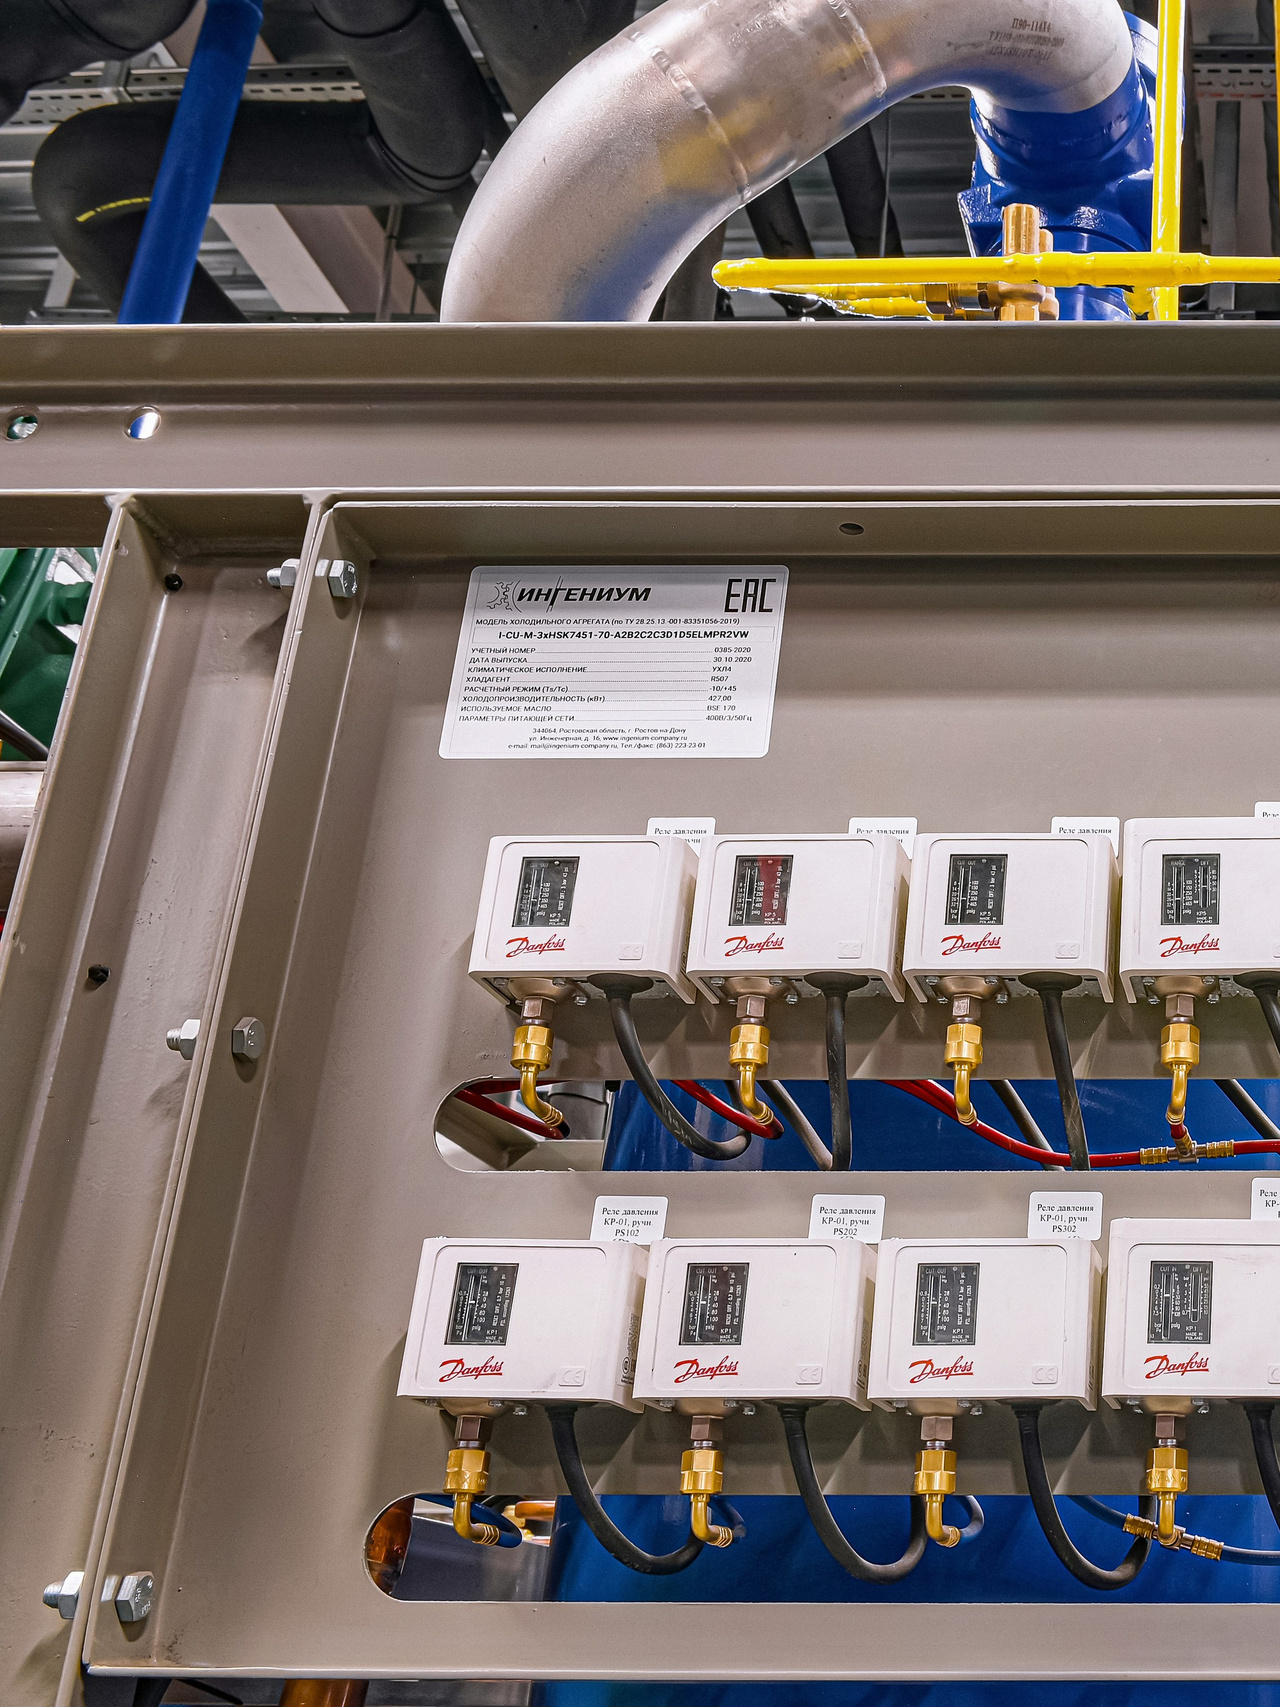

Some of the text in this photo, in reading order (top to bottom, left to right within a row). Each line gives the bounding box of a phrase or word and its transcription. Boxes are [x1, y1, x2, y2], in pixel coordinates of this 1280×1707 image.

[516, 583, 652, 607] ИНГЕНИУМ
[724, 578, 777, 613] EAC
[475, 618, 509, 626] МОДЕЛЬ
[509, 618, 572, 626] ХОЛОДИЛЬНОГО
[611, 618, 623, 626] (по
[469, 657, 490, 665] ДАТА
[465, 676, 511, 684] ХЛАДАГЕНТ
[507, 715, 554, 723] ПИТАЮЩЕЙ
[656, 742, 673, 750] (863)
[654, 827, 671, 835] Реле
[856, 827, 873, 835] Реле
[505, 933, 566, 958] Danfoss
[724, 932, 785, 957] Danfoss
[941, 932, 1001, 956] Danfoss
[1159, 932, 1220, 958] Danfoss
[1260, 1189, 1277, 1197] Реле
[601, 1207, 620, 1215] Реле
[819, 1206, 837, 1214] Реле
[1037, 1204, 1055, 1212] Реле
[615, 1228, 640, 1237] PS102
[833, 1227, 858, 1236] PS202
[1052, 1225, 1077, 1233] PS302
[439, 1355, 504, 1382] Danfoss
[1143, 1351, 1210, 1379] Danfoss
[673, 1355, 739, 1384] Danfoss
[908, 1355, 974, 1384] Danfoss
